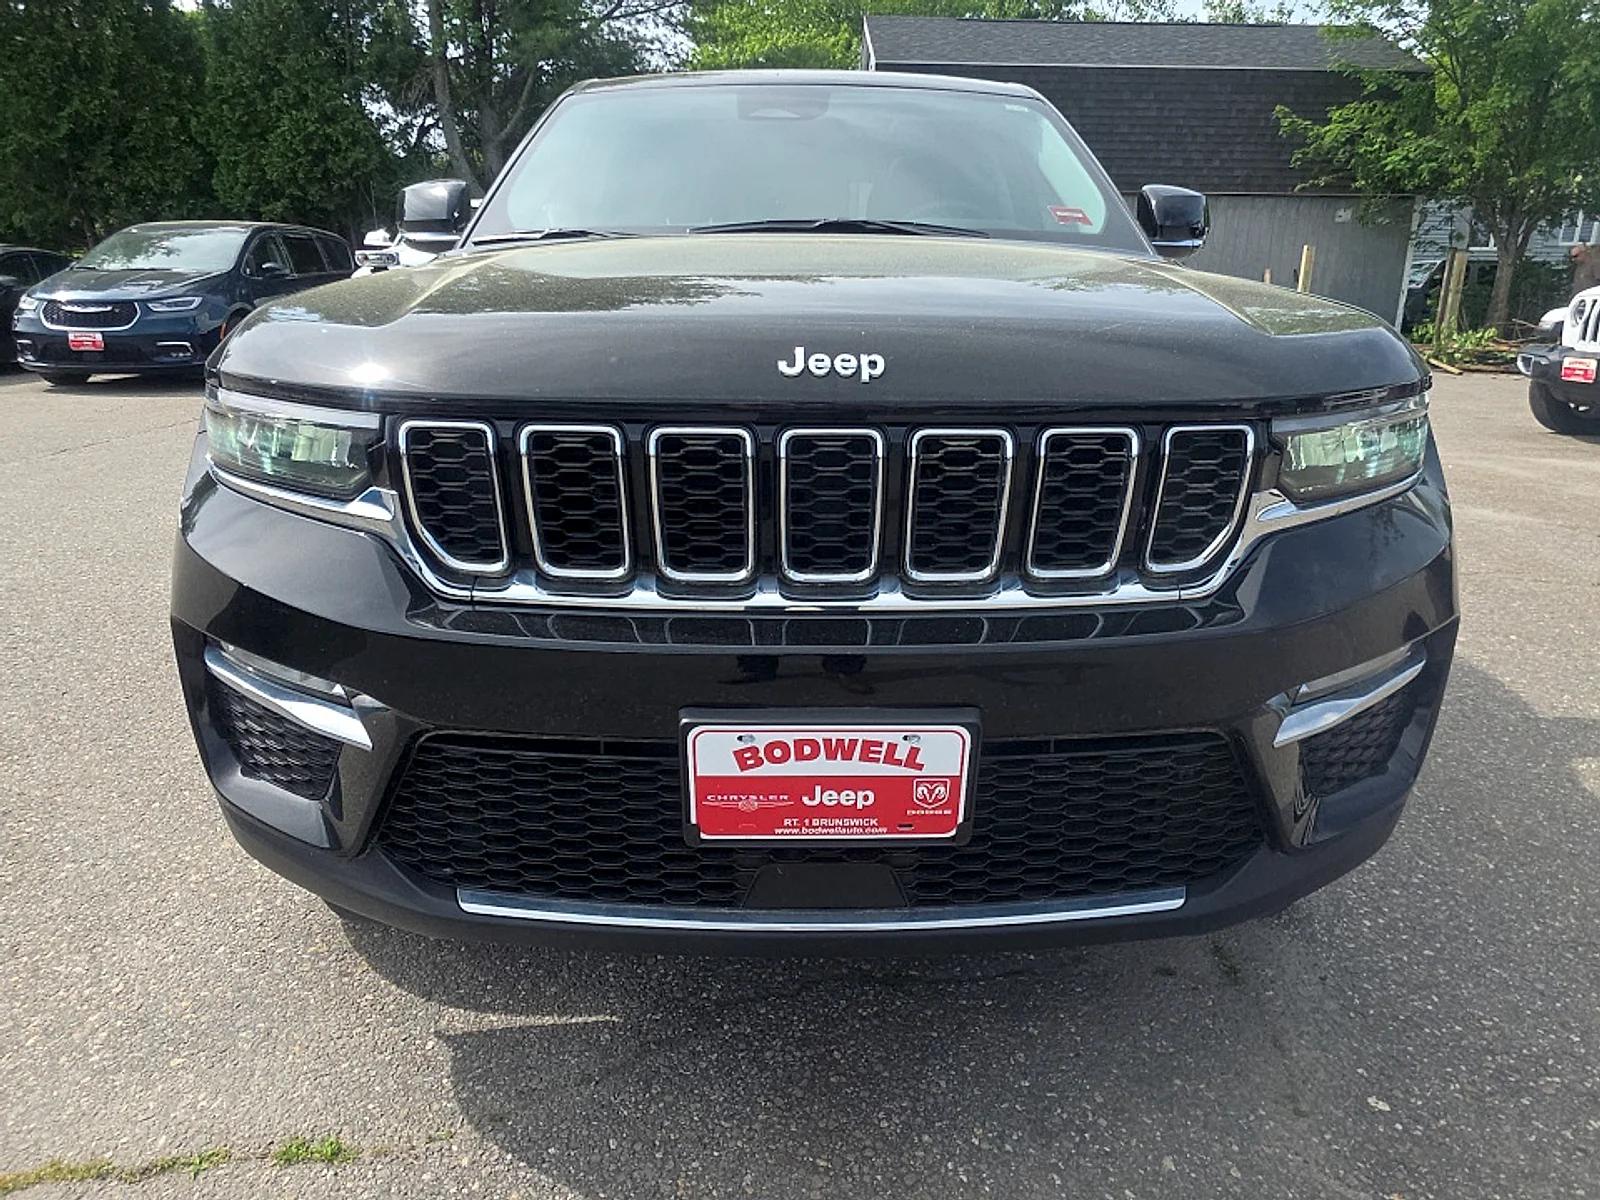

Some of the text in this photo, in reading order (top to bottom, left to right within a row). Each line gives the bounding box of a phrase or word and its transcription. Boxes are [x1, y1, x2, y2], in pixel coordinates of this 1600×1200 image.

[777, 346, 885, 383] Jeep
[732, 737, 926, 773] BODWELL
[801, 785, 875, 809] Jeep
[774, 826, 888, 835] www.bodwellauto.com
[803, 818, 810, 827] 1
[812, 818, 879, 827] BRUNSWICK
